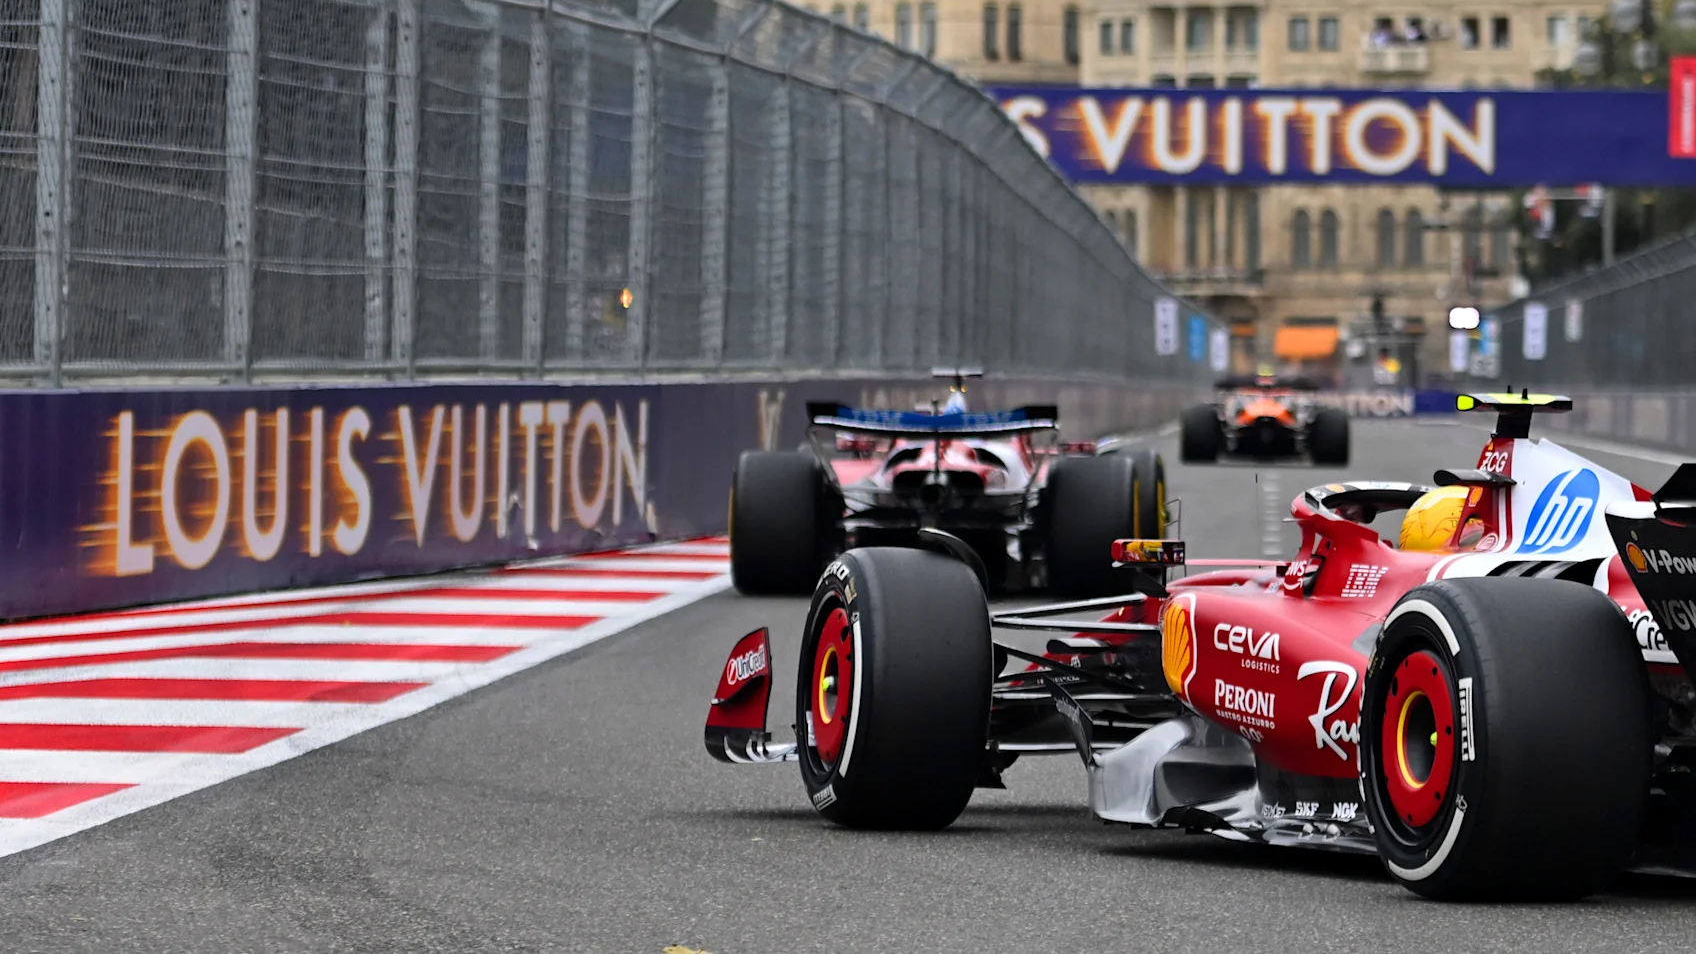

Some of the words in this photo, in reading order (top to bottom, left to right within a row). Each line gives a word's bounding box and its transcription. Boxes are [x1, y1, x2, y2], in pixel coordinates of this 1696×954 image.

[1078, 95, 1495, 176] VUITTON
[1479, 451, 1508, 473] ZCG
[116, 405, 373, 575] LOUIS
[400, 399, 649, 547] VUITTON
[1522, 469, 1596, 553] hp
[1341, 564, 1389, 597] IBM
[736, 644, 765, 680] UniCredit
[1241, 658, 1280, 674] LOGISTICS
[1215, 679, 1276, 718] PERONI
[1216, 710, 1241, 722] NASTRO
[1243, 714, 1275, 729] AZZURRO
[1458, 677, 1475, 761] PIRELLI
[1295, 801, 1319, 817] SKF
[1331, 802, 1358, 819] NGK
